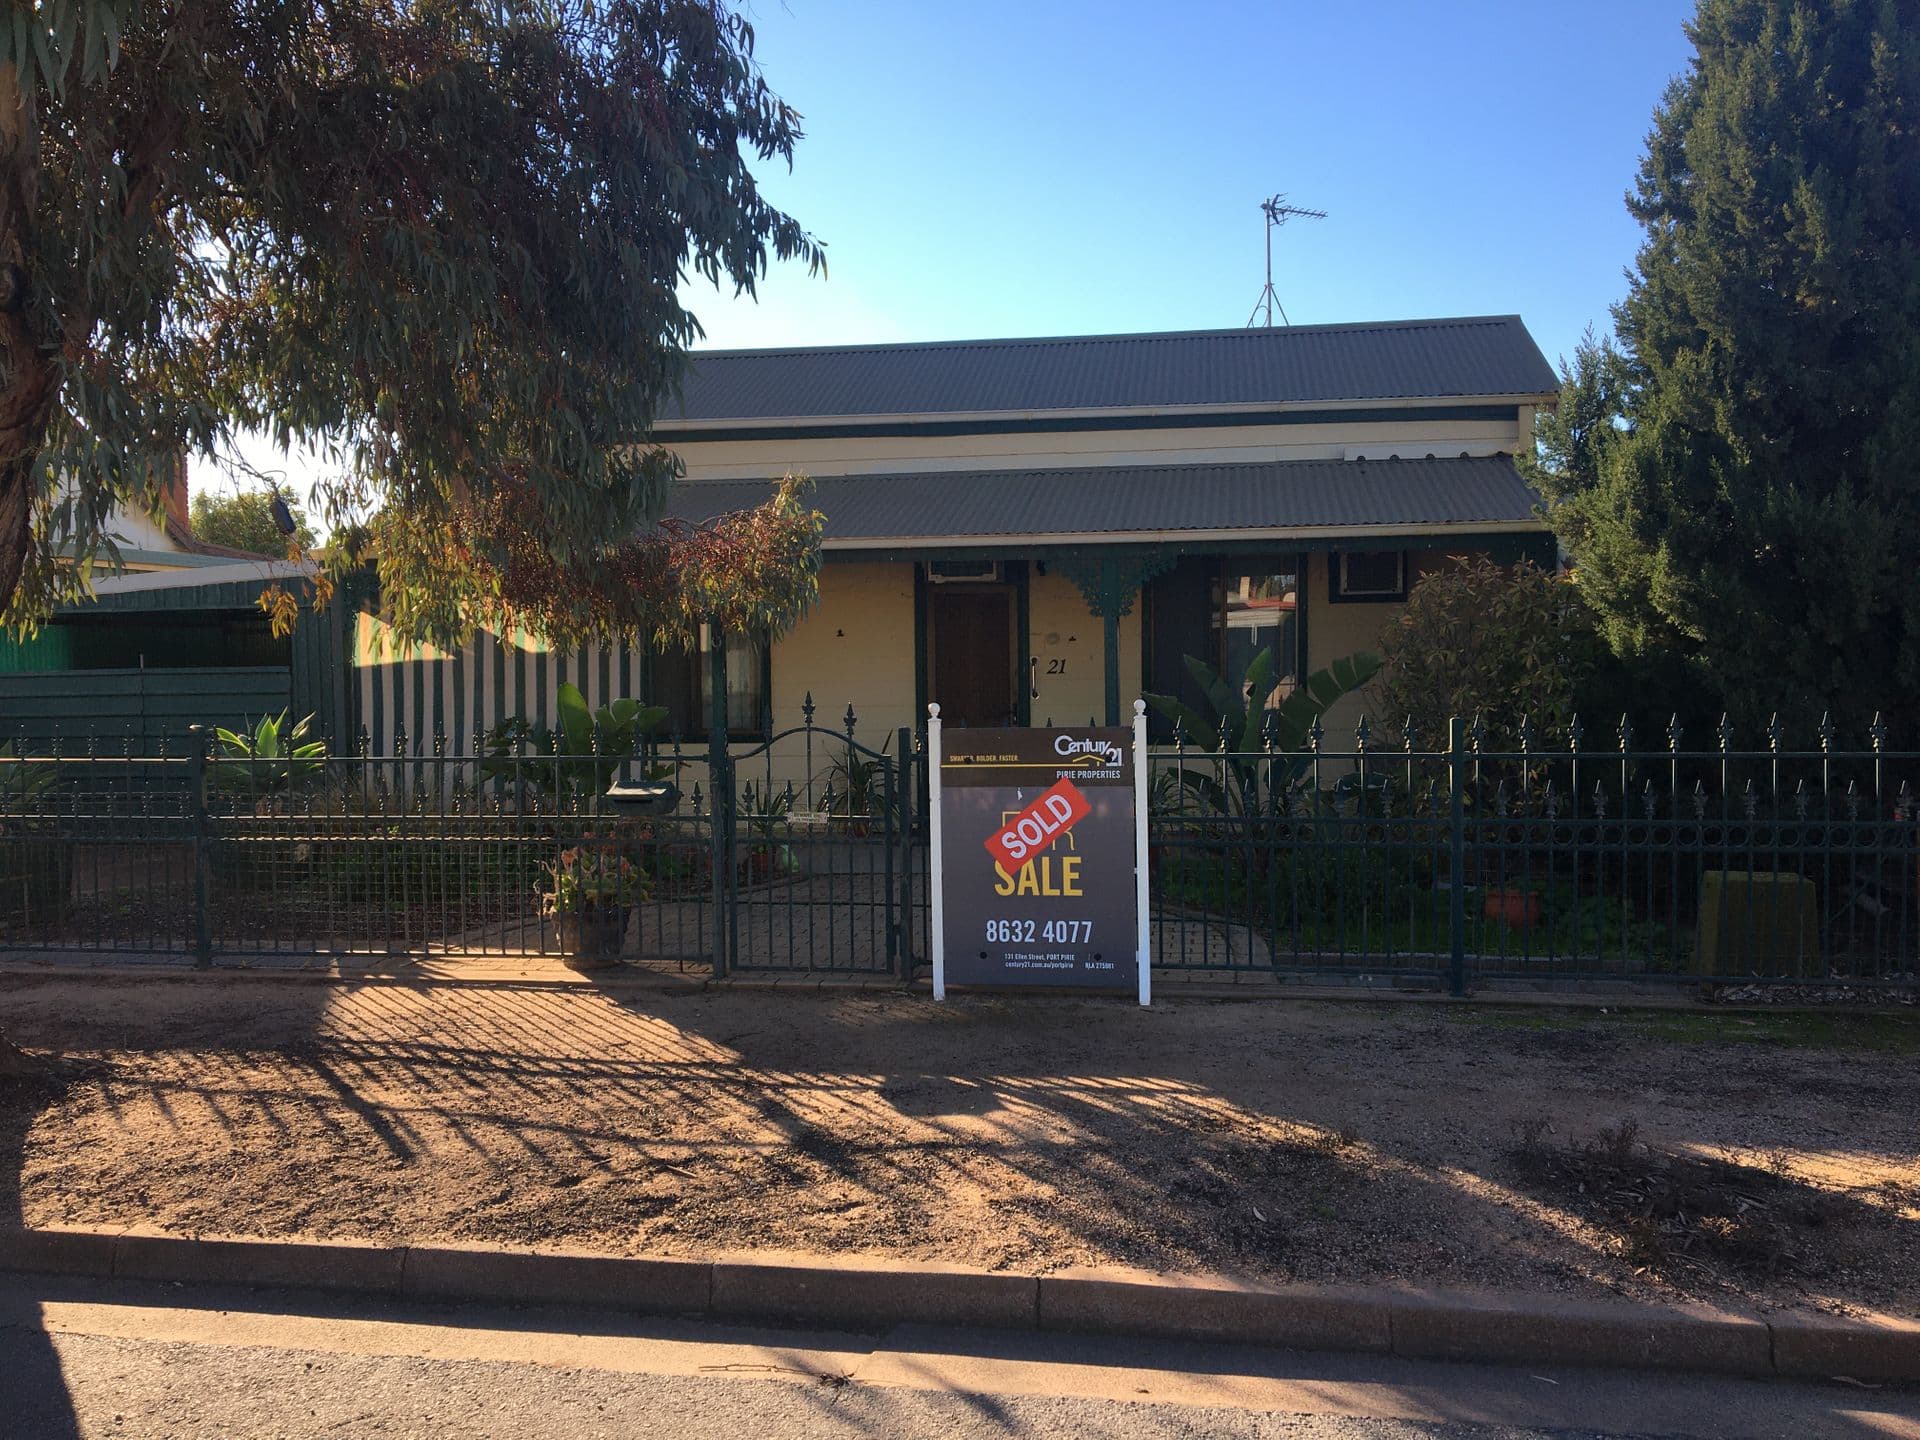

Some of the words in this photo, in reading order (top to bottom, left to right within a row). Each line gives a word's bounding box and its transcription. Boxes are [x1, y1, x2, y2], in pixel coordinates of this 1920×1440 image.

[1046, 658, 1066, 675] 21
[1054, 735, 1112, 756] Century
[1105, 747, 1123, 767] 21
[1056, 770, 1076, 779] PIRIE
[1077, 770, 1121, 779] PROPERTIES
[1001, 794, 1073, 859] SOLD
[994, 856, 1083, 896] SALE
[986, 919, 1036, 943] 8632
[1042, 919, 1092, 943] 4077
